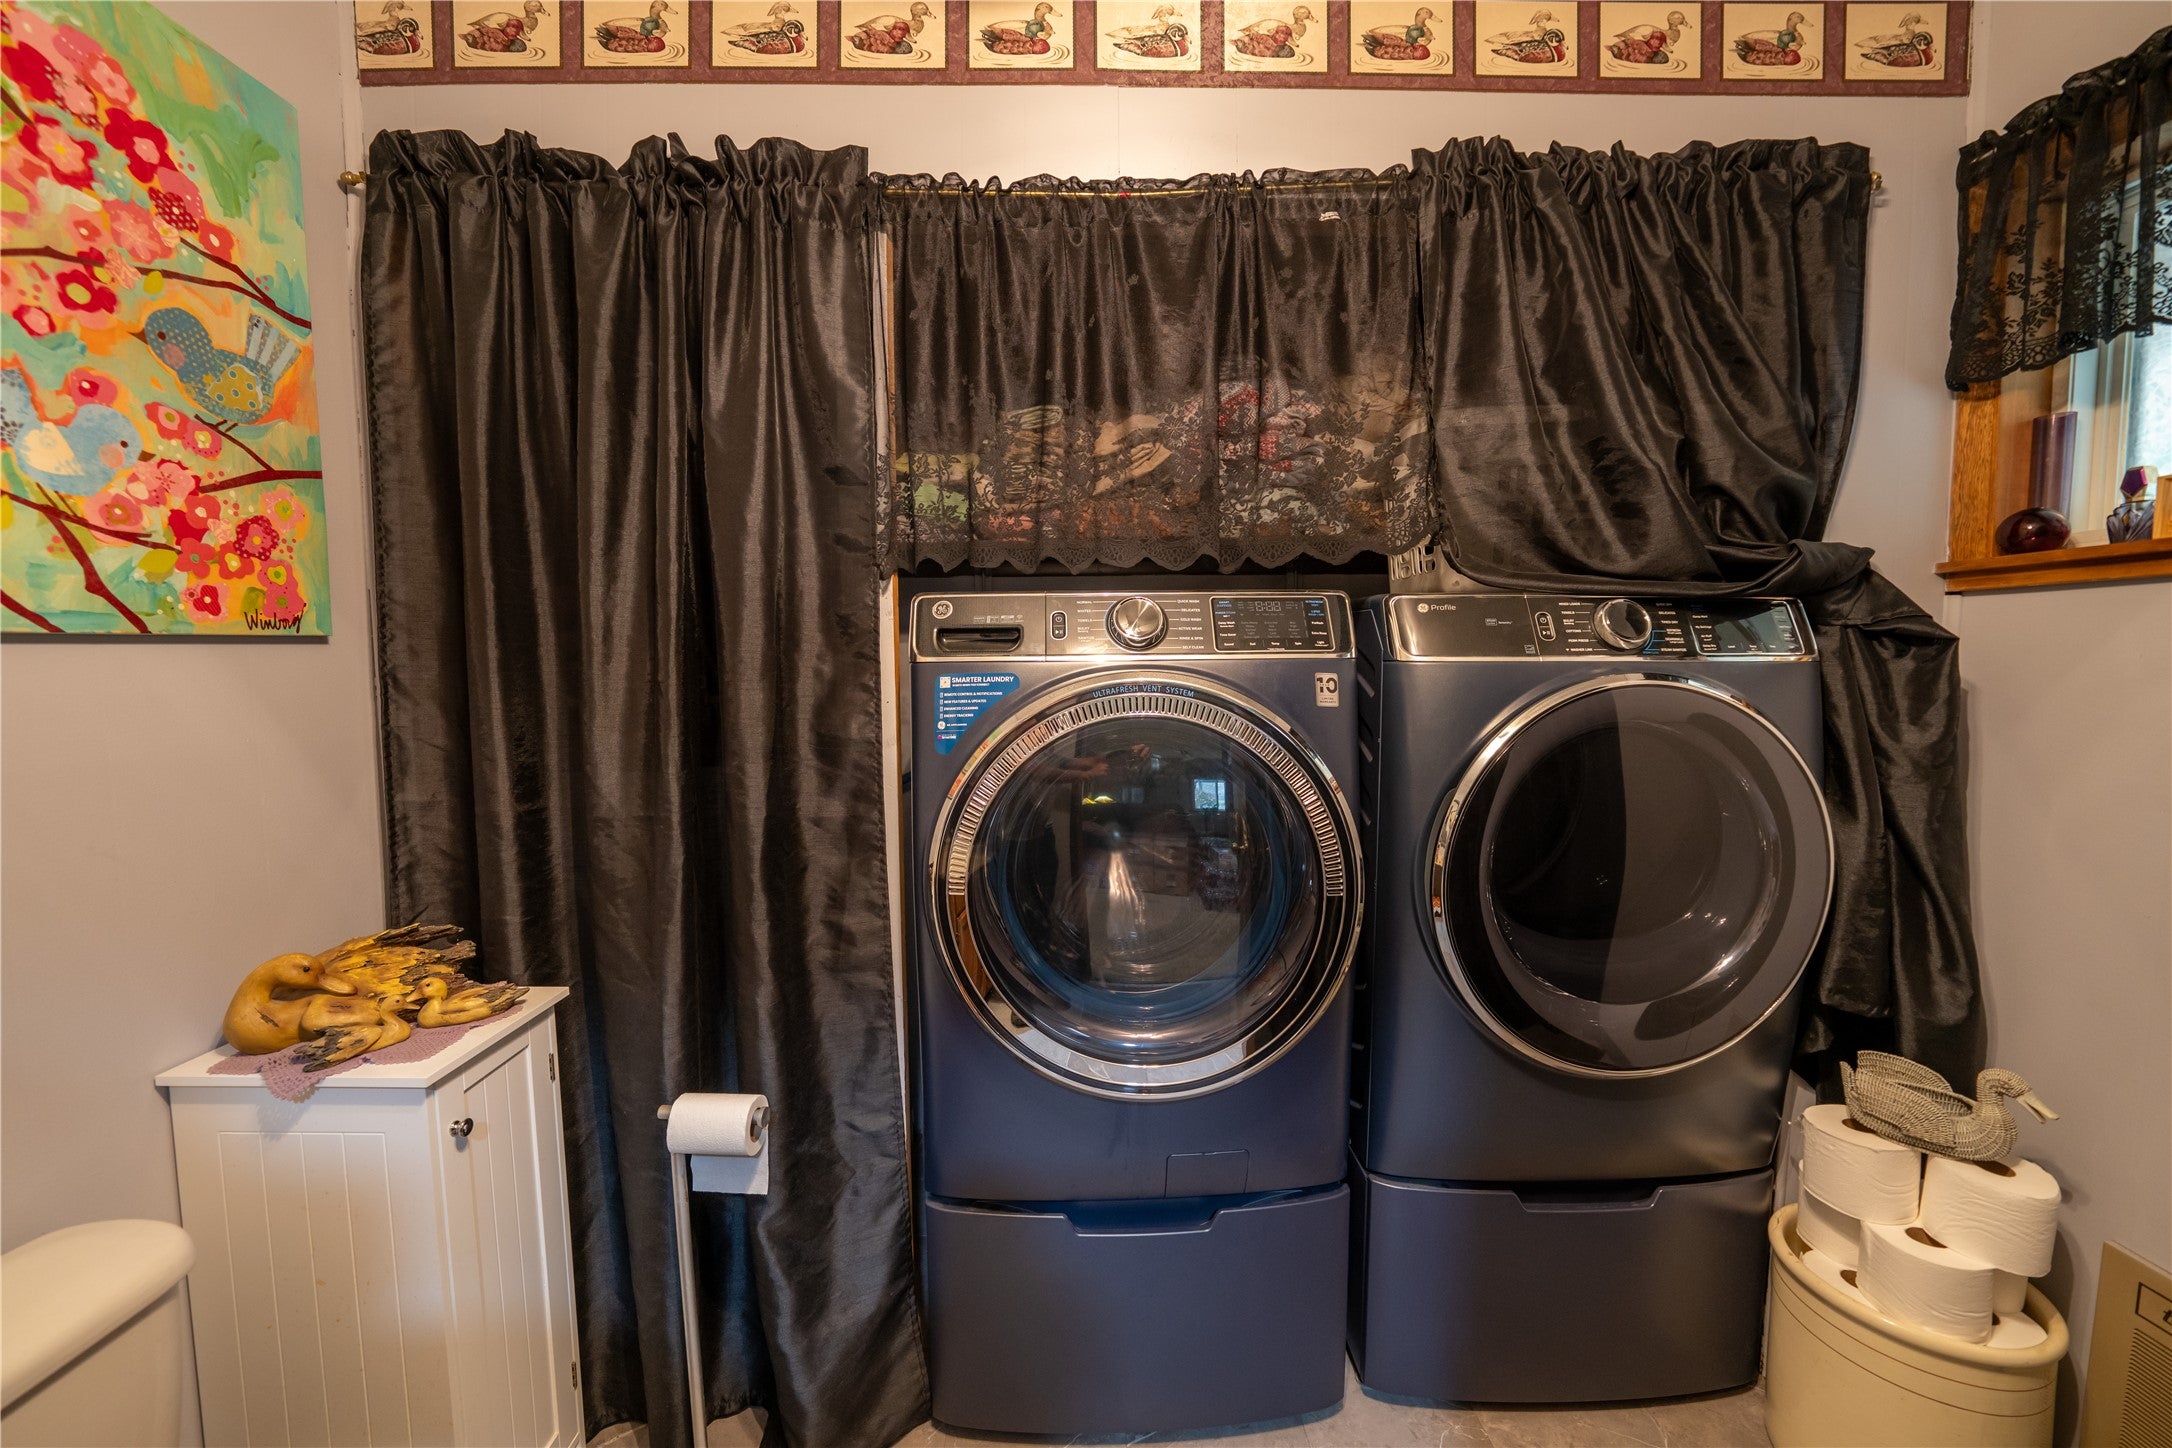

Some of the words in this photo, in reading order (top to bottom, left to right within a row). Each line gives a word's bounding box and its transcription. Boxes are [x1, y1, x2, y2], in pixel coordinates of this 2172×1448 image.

[1092, 686, 1139, 698] ULTRAFRESH
[1166, 686, 1194, 697] SYSTEM
[1317, 677, 1337, 693] 10
